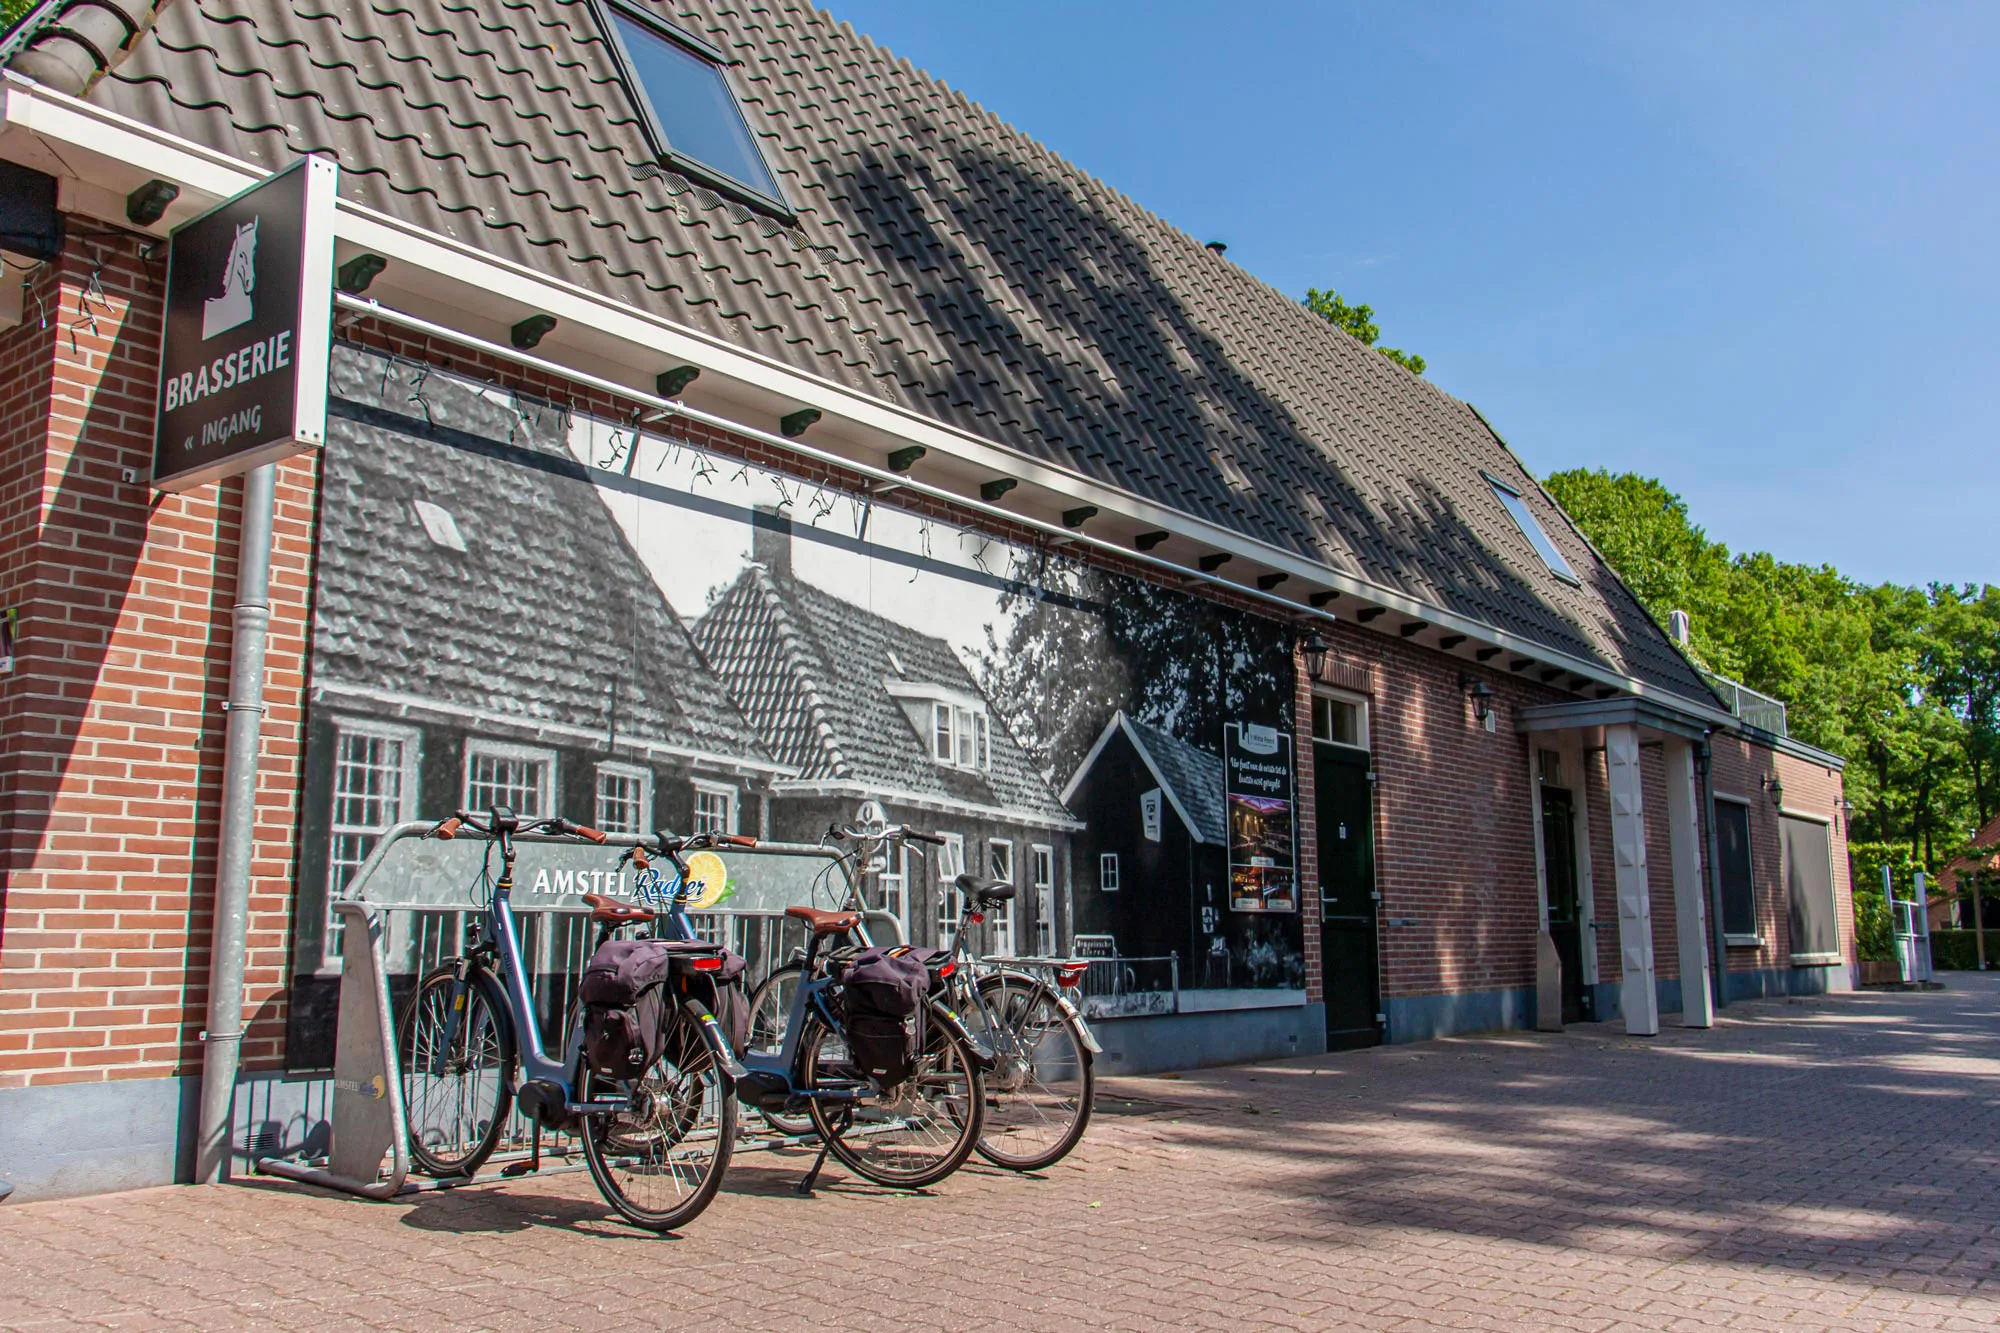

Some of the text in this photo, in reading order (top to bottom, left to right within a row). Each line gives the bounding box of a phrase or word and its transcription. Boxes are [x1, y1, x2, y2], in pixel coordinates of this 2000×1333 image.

[165, 330, 291, 412] BRASSERIE
[201, 405, 262, 446] INGANG
[532, 868, 705, 905] AMSTEL Rader
